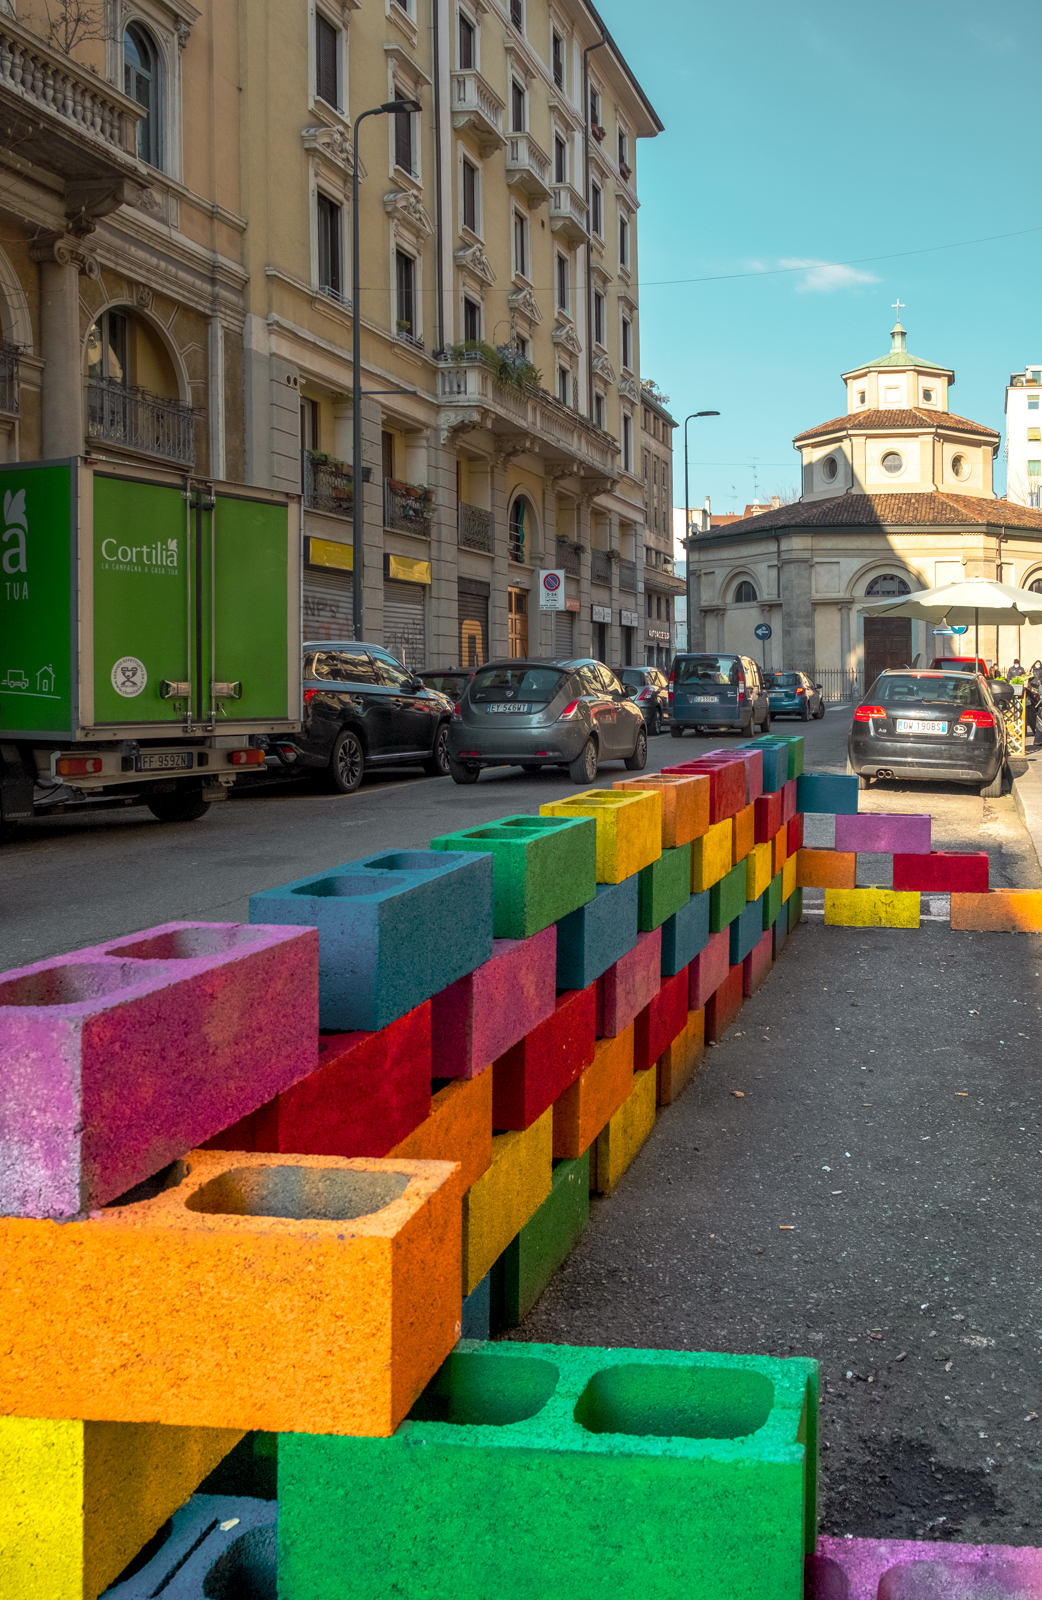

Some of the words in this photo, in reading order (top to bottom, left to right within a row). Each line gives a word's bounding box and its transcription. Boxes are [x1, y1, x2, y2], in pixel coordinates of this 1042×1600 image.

[101, 538, 177, 566] Cortilia
[101, 562, 109, 570] LA
[168, 568, 178, 576] TUA
[5, 581, 29, 600] TUA
[916, 722, 941, 731] 190BS
[142, 755, 155, 768] FF
[158, 754, 187, 767] 959ZN
